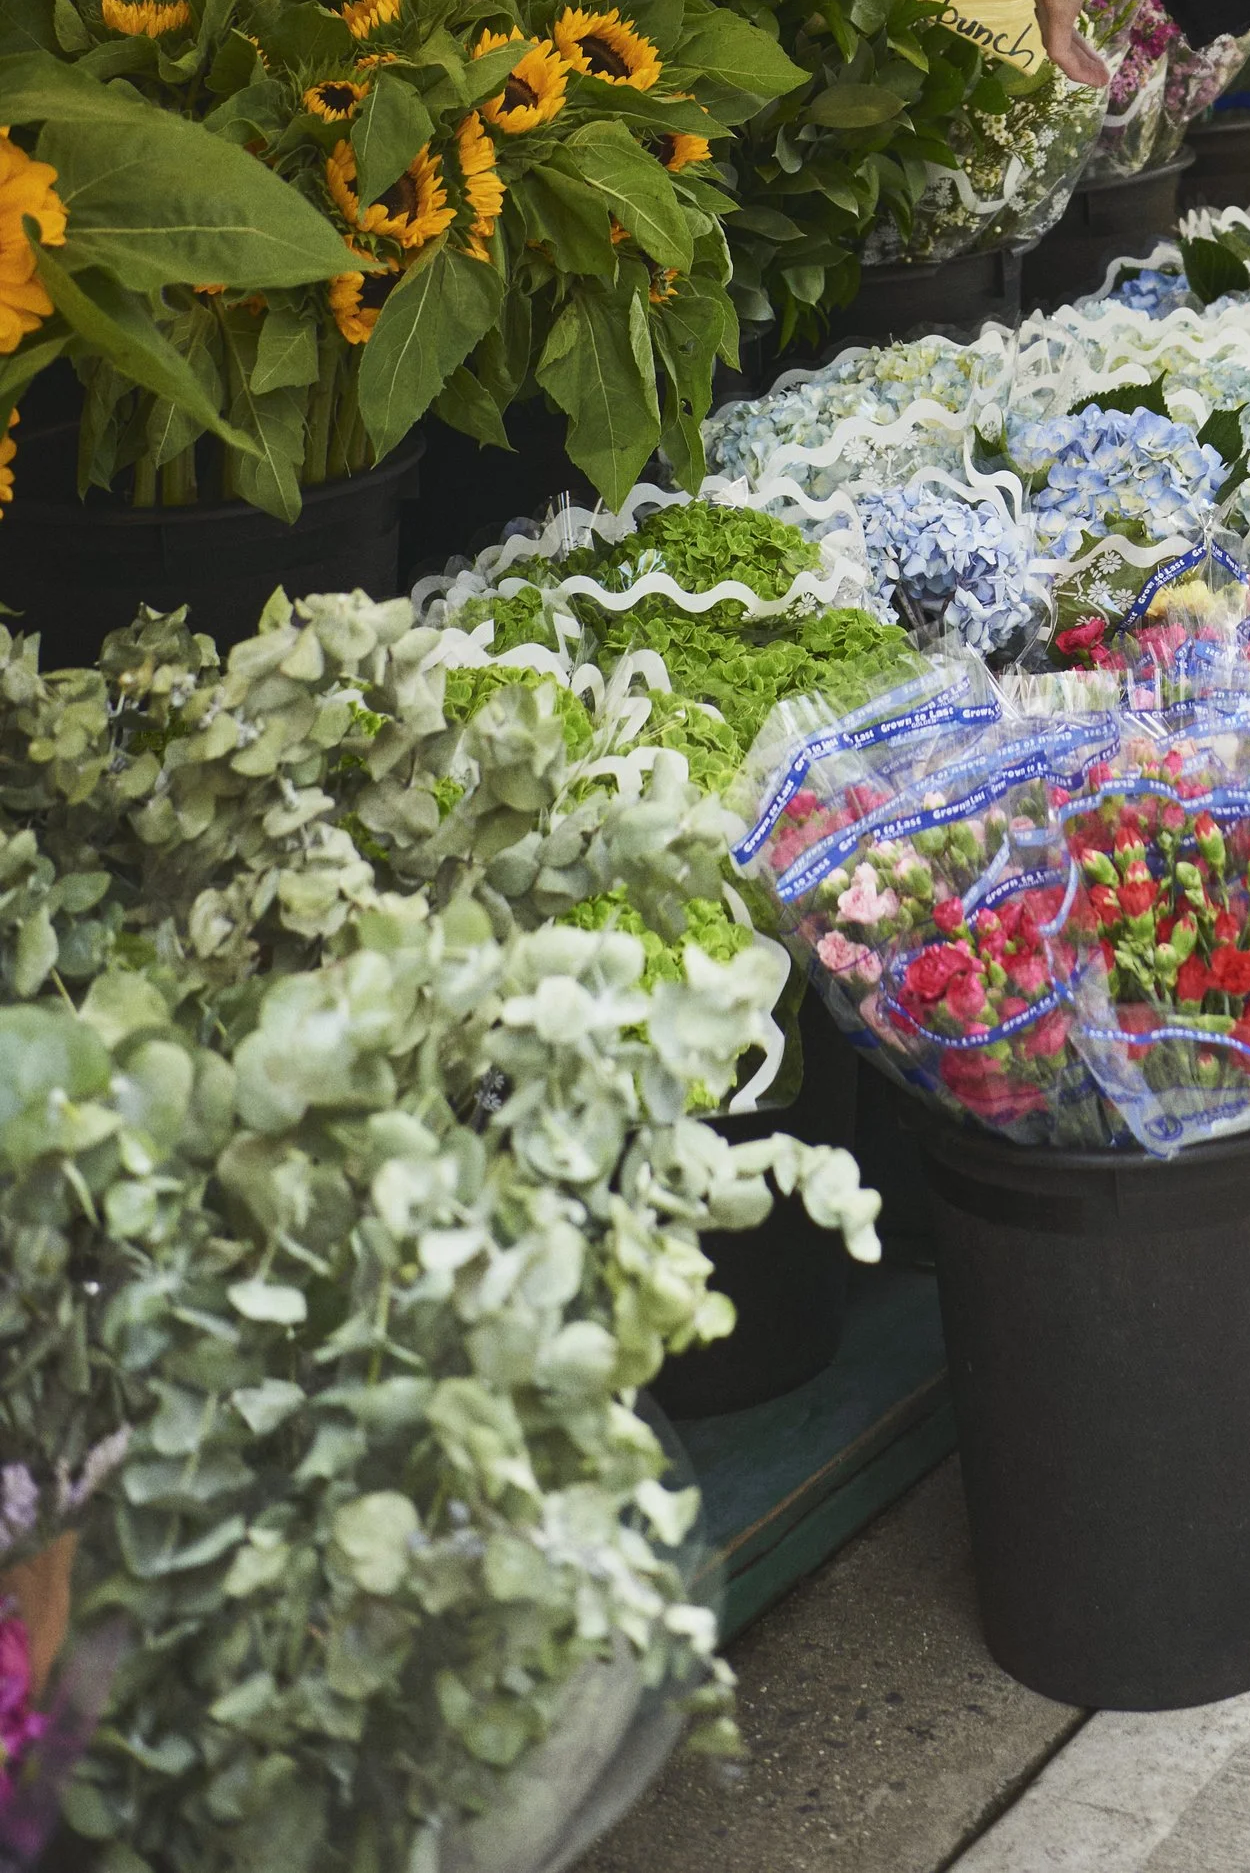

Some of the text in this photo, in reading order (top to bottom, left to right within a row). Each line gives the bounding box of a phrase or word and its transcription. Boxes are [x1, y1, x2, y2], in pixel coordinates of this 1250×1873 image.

[1164, 559, 1186, 577] Last
[880, 717, 912, 734] Grown
[929, 707, 955, 721] Last
[743, 817, 771, 854] Grown
[776, 779, 795, 804] Last
[896, 815, 923, 830] Last
[806, 858, 832, 879] Last
[985, 879, 1019, 905] Grown
[1002, 1005, 1038, 1033] Grown
